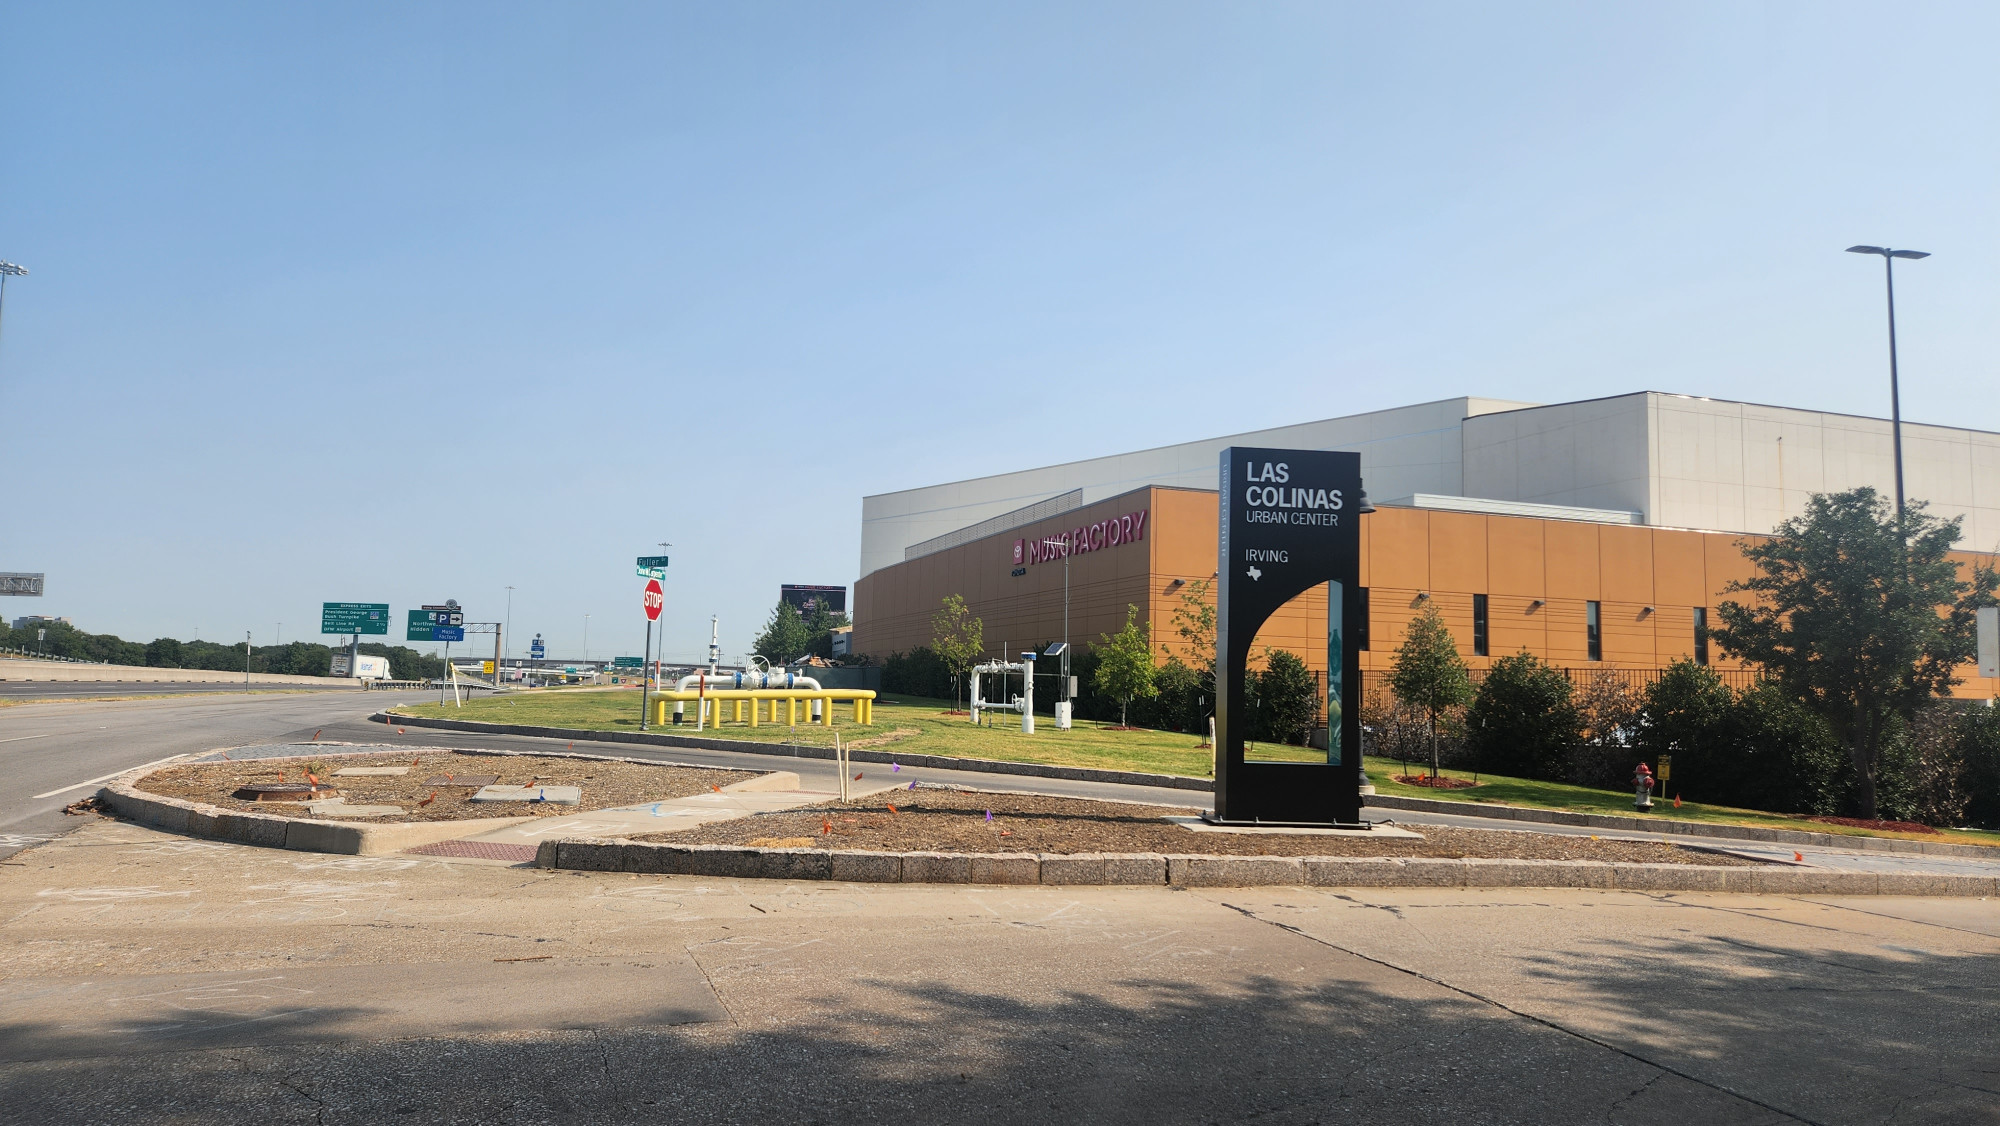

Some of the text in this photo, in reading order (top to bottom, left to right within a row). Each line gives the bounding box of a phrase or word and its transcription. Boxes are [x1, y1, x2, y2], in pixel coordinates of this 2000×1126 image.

[1247, 461, 1289, 483] LAS
[1245, 485, 1343, 510] COLINAS
[1246, 510, 1287, 524] URBAN
[1291, 512, 1338, 526] CENTER
[1029, 509, 1148, 565] MUSIC FACTORY
[1245, 549, 1289, 563] IRVING
[644, 591, 662, 608] STOP
[440, 614, 447, 623] P
